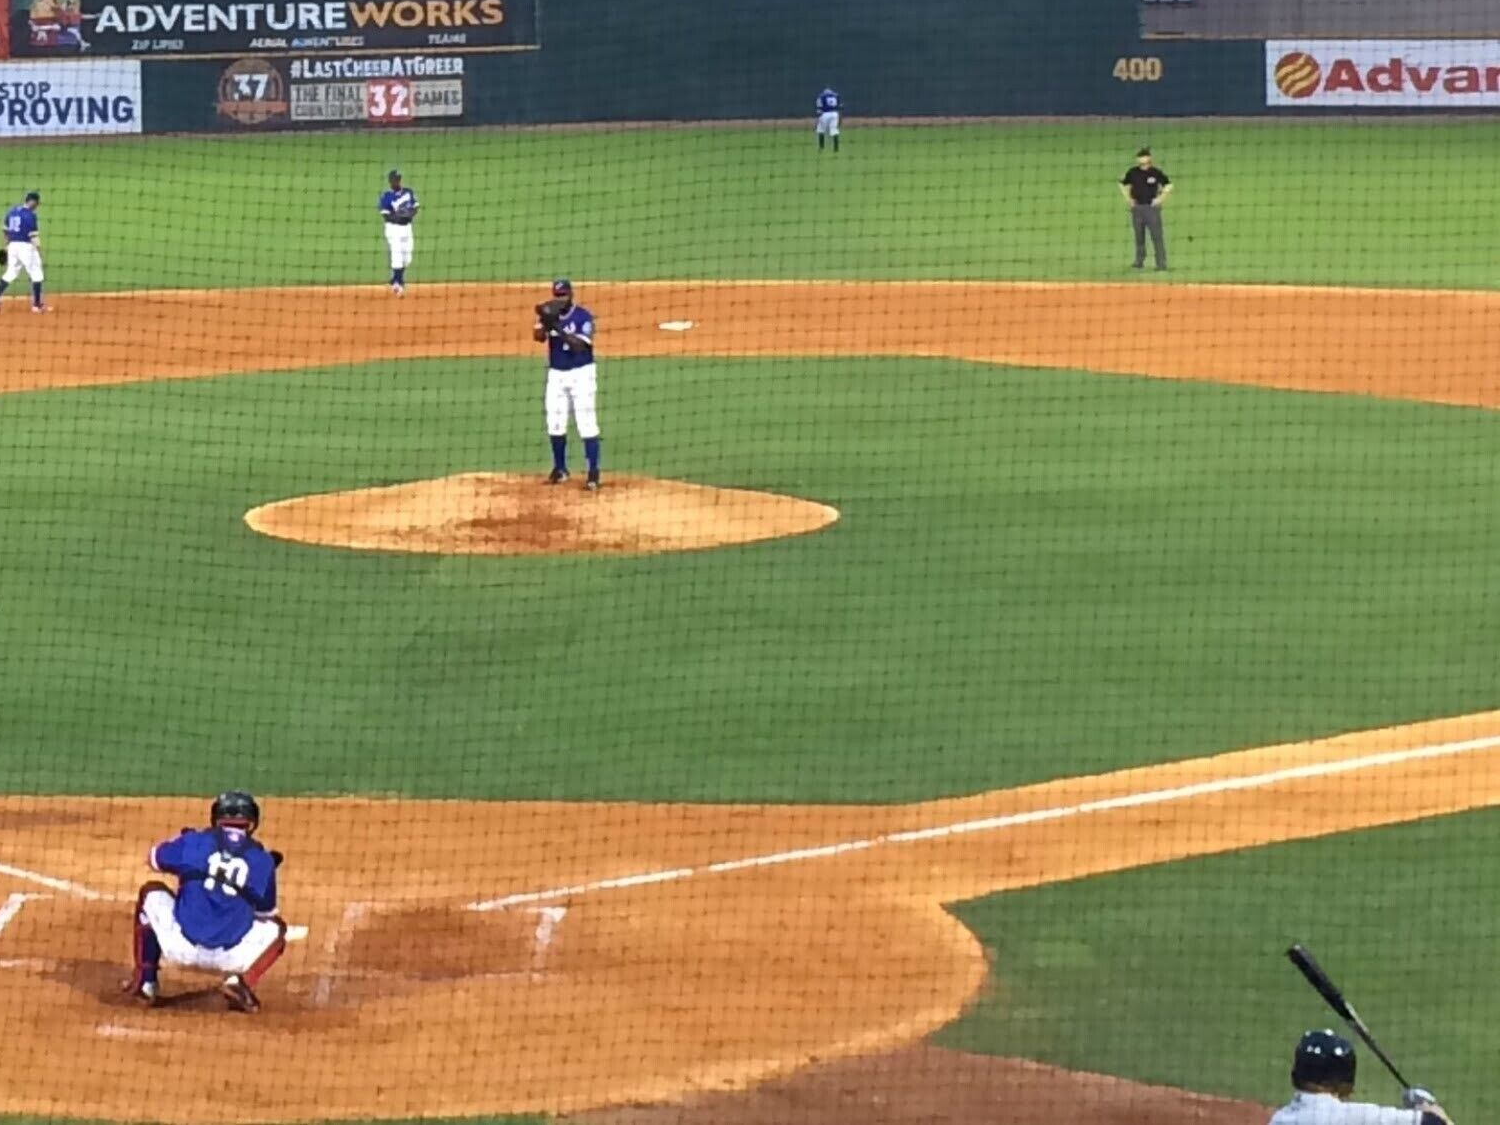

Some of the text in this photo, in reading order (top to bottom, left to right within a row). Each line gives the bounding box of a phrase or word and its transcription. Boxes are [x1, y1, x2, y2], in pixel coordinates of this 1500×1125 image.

[1112, 57, 1163, 81] 400
[0, 82, 52, 100] STOP
[233, 73, 269, 103] 37
[414, 90, 461, 106] GAMES
[369, 84, 410, 117] 32
